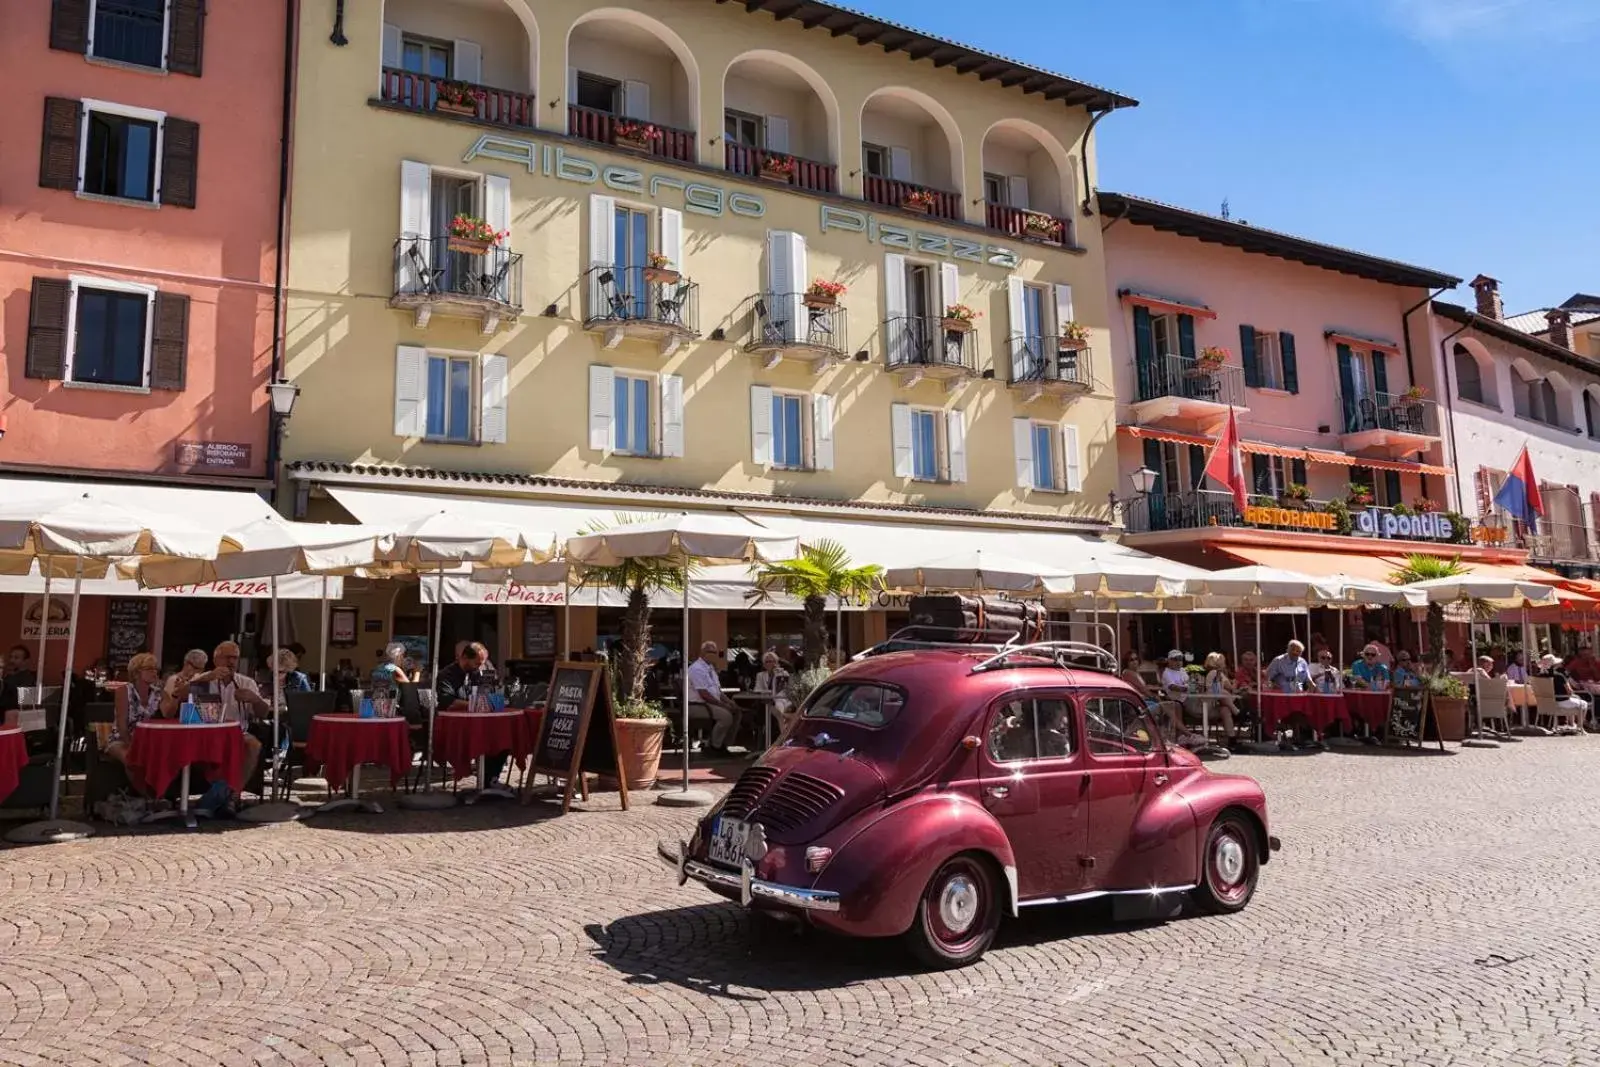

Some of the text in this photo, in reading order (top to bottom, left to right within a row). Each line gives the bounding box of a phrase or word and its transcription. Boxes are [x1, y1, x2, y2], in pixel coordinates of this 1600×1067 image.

[462, 133, 1020, 269] Albergo Piazza
[208, 443, 239, 451] ALBERGO
[207, 457, 235, 465] ENTRATA
[1246, 507, 1338, 530] RISTORANTE
[1385, 512, 1452, 539] pontile
[484, 581, 565, 603] al Piazza
[24, 627, 70, 636] PIZERIA
[559, 685, 583, 698] PASTA
[555, 703, 578, 715] PIZZA
